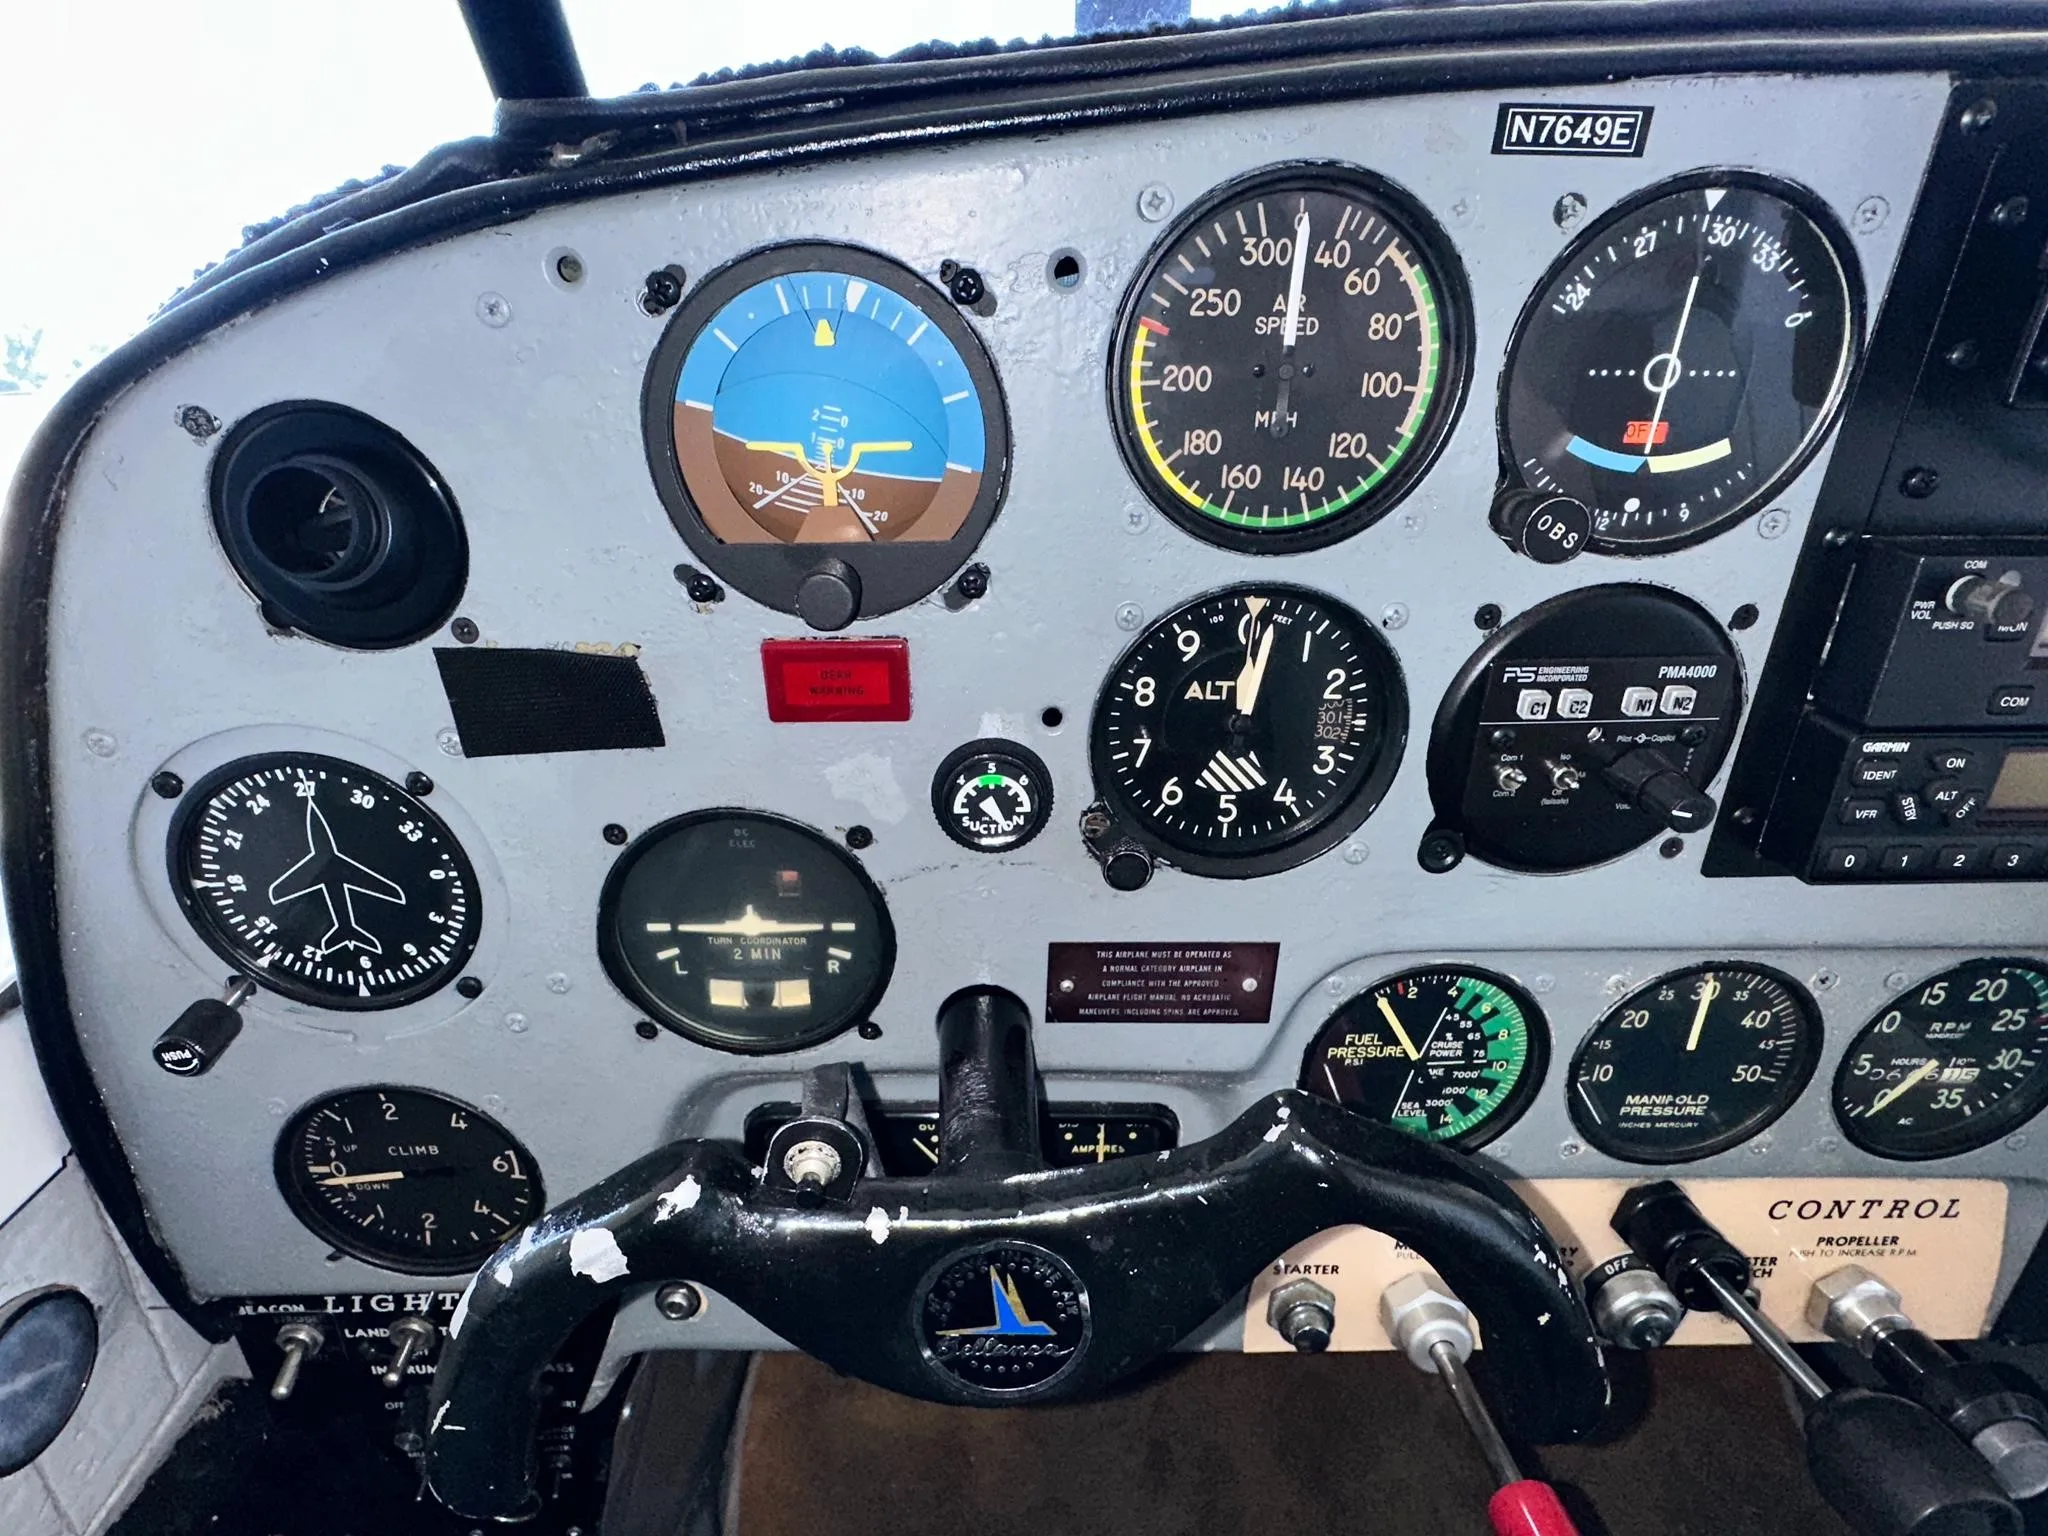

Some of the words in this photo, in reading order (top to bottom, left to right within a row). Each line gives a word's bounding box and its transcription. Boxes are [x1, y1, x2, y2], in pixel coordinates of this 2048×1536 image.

[1510, 115, 1635, 145] N7649E
[1708, 221, 1736, 246] 30
[1240, 237, 1292, 266] 300
[1633, 231, 1658, 258] 27
[1314, 240, 1351, 268] 40
[1752, 244, 1781, 272] 33
[1344, 267, 1381, 296] 60
[1189, 288, 1242, 317] 250
[1565, 285, 1592, 311] 24
[1367, 313, 1402, 341] 80
[1162, 365, 1212, 392] 200
[1361, 372, 1403, 398] 100
[1183, 429, 1222, 455] 180
[1328, 433, 1367, 458] 120
[776, 471, 789, 483] 10
[1221, 464, 1261, 490] 160
[1283, 466, 1324, 491] 140
[748, 482, 764, 495] 20
[851, 488, 866, 500] 10
[873, 511, 889, 522] 20
[1536, 515, 1579, 550] OBS
[1964, 560, 1987, 569] COM
[1913, 601, 1935, 609] PWR
[1210, 615, 1224, 624] 100
[1272, 614, 1293, 625] FEET
[1911, 611, 1932, 619] VOL
[1932, 622, 1958, 630] PUSH
[1177, 630, 1201, 662] 9
[1302, 631, 1312, 662] 1
[1539, 666, 1589, 674] ENGINEERING
[1658, 665, 1717, 679] PMA4000
[1184, 680, 1236, 700] ALT
[1323, 668, 1346, 700] 2
[1135, 676, 1155, 707] 8
[1570, 701, 1588, 714] C2
[1636, 699, 1652, 712] N1
[1673, 697, 1692, 710] N2
[2000, 697, 2029, 706] COM
[1530, 703, 1547, 716] C1
[1652, 735, 1676, 743] Copilot
[1133, 738, 1152, 768] 7
[1862, 742, 1910, 752] GARMIN
[1313, 745, 1335, 775] 3
[1946, 758, 1965, 768] ON
[987, 763, 996, 773] 5
[1863, 770, 1897, 780] IDENT
[956, 774, 965, 785] 4
[1019, 774, 1029, 785] 6
[1161, 777, 1183, 806] 6
[1273, 778, 1296, 806] 4
[1935, 791, 1958, 800] ALT
[246, 794, 271, 815] 24
[350, 789, 375, 809] 30
[1217, 795, 1237, 822] 5
[1855, 809, 1878, 819] VFR
[1902, 797, 1917, 821] STBY
[1955, 797, 1976, 819] OFF
[398, 820, 423, 842] 33
[962, 815, 1024, 834] SUCTION
[224, 829, 244, 850] 21
[1844, 855, 1855, 867] 0
[1901, 855, 1908, 867] 1
[1953, 855, 1965, 867] 2
[2007, 855, 2019, 867] 3
[708, 936, 733, 944] TURN
[740, 936, 807, 945] COORDINATOR
[734, 949, 742, 960] 2
[751, 949, 782, 960] MIN
[675, 960, 688, 974] L
[828, 960, 840, 974] R
[1407, 987, 1418, 999] 2
[1448, 985, 1458, 997] 4
[1658, 990, 1675, 1000] 25
[1733, 990, 1749, 1000] 35
[1920, 982, 1949, 1005] 15
[1968, 979, 2008, 1002] 20
[1481, 1003, 1492, 1013] 6
[1620, 1010, 1649, 1028] 20
[1741, 1011, 1771, 1028] 40
[1874, 1011, 1901, 1033] 10
[1991, 1009, 2030, 1031] 25
[1498, 1029, 1508, 1039] 8
[1929, 1022, 1972, 1032] RPM
[1344, 1034, 1382, 1045] FUEL
[1467, 1032, 1480, 1040] 65
[1599, 1040, 1611, 1049] 15
[1759, 1041, 1775, 1049] 45
[1328, 1046, 1404, 1059] PRESSURE
[1988, 1049, 2022, 1070] 30
[1492, 1061, 1507, 1071] 10
[1854, 1054, 1874, 1075] 5
[1592, 1065, 1613, 1081] 10
[1731, 1065, 1761, 1082] 50
[1475, 1088, 1488, 1099] 12
[1625, 1095, 1709, 1105] MANIFOLD
[1930, 1088, 1965, 1109] 35
[382, 1103, 399, 1121] 2
[1619, 1106, 1707, 1115] PRESSURE
[451, 1113, 468, 1129] 4
[1440, 1114, 1453, 1124] 14
[343, 1145, 357, 1153] UP
[388, 1146, 440, 1156] CLIMB
[330, 1161, 347, 1179] 0
[492, 1156, 508, 1172] 6
[474, 1200, 491, 1215] 4
[1768, 1199, 1960, 1220] CONTROL
[421, 1213, 437, 1229] 2
[1816, 1236, 1899, 1247] PROPELLER
[1819, 1249, 1833, 1257] TO
[1838, 1249, 1885, 1257] INCREASE
[1272, 1264, 1340, 1275] STARTER
[1604, 1257, 1629, 1275] OFF
[344, 1328, 390, 1337] LAND
